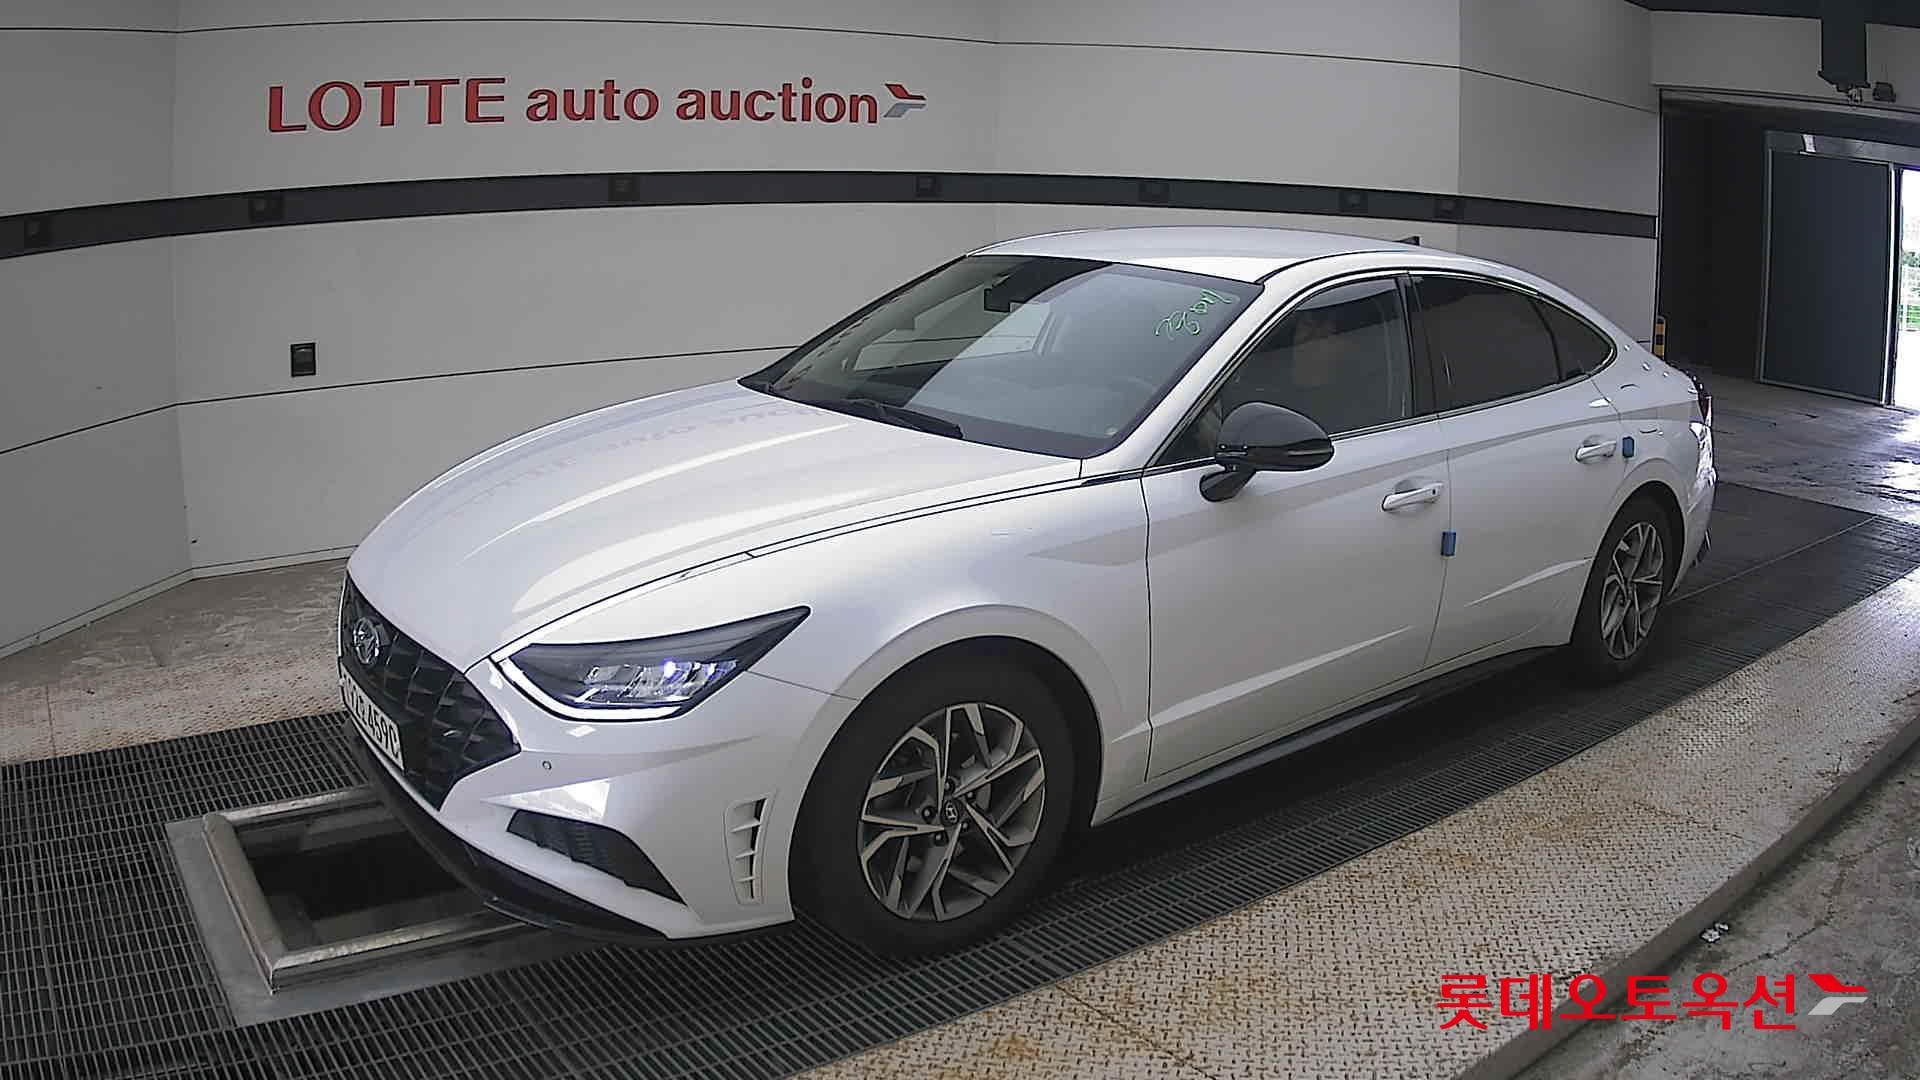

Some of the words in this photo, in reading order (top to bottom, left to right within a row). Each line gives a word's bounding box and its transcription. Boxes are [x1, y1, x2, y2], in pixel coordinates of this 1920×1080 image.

[267, 77, 506, 134] LOTTE
[526, 79, 660, 122] auto
[676, 78, 878, 124] auction
